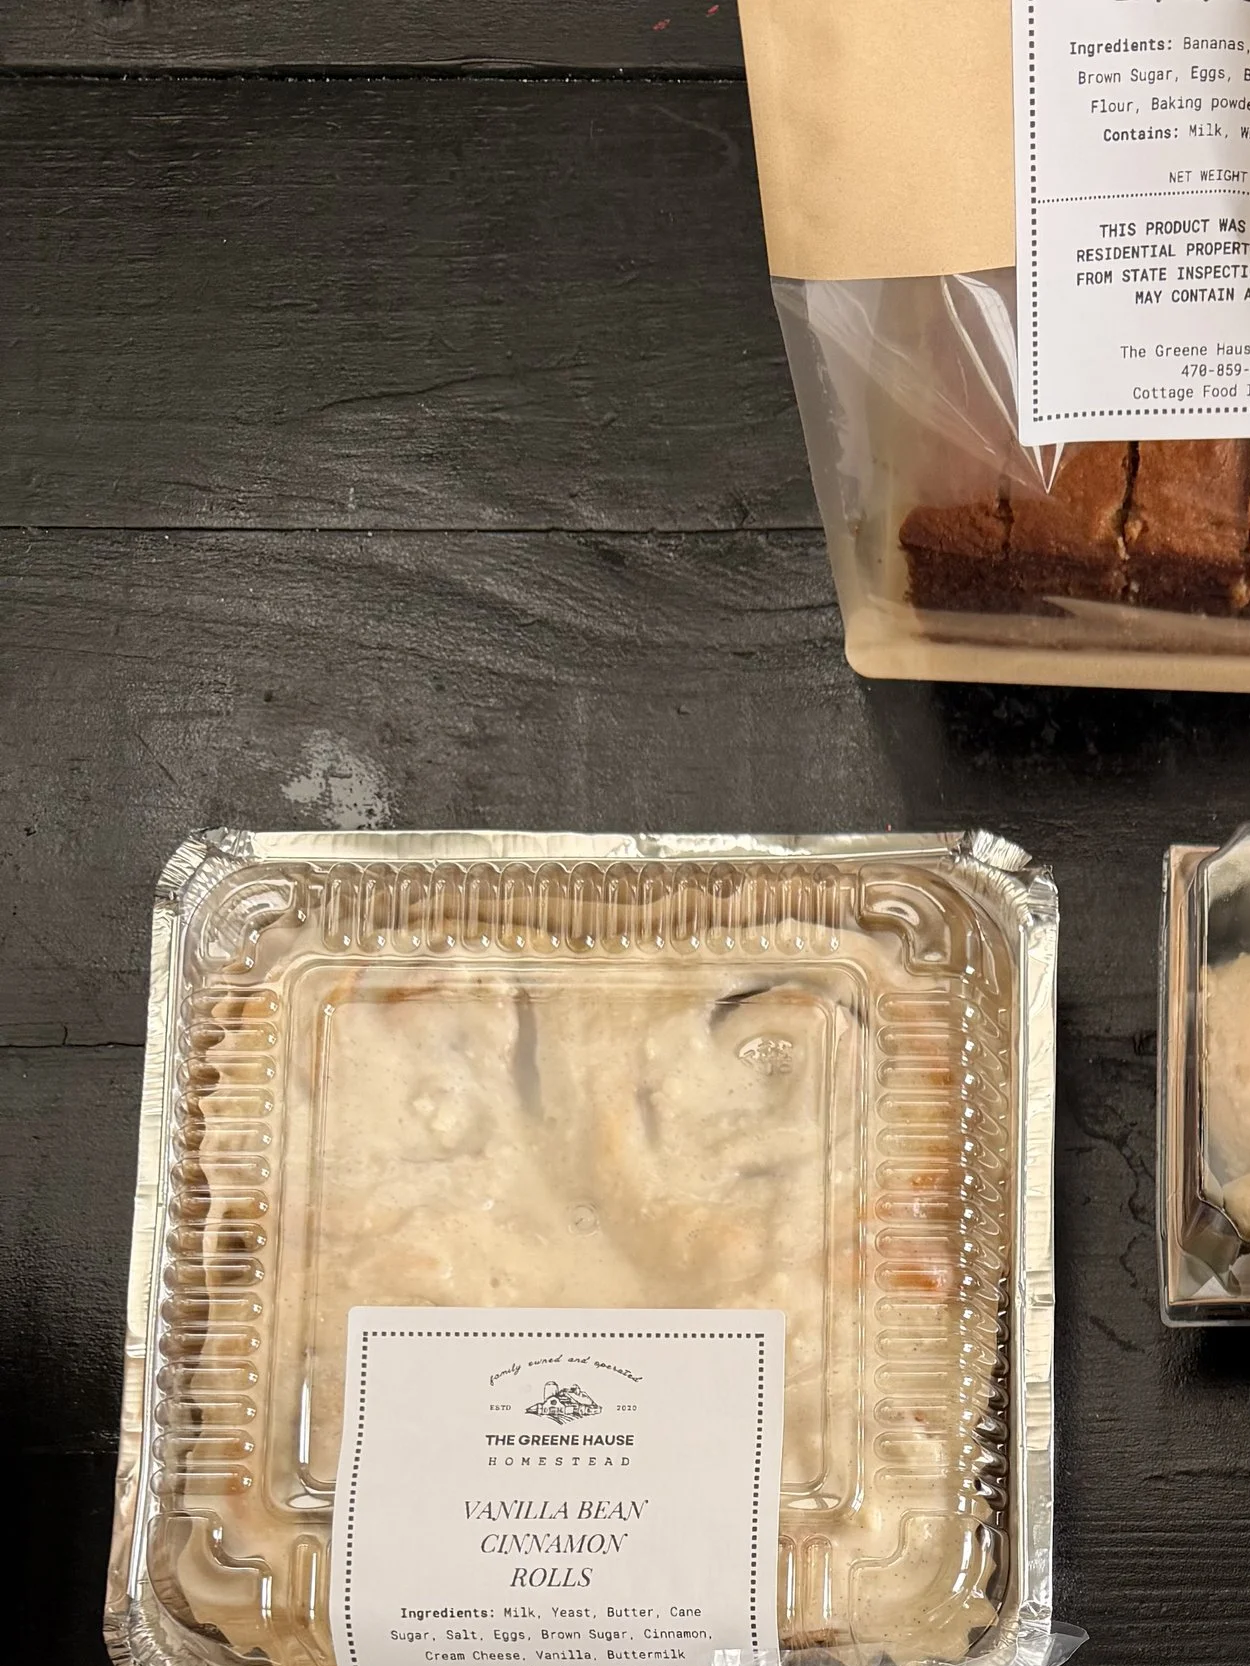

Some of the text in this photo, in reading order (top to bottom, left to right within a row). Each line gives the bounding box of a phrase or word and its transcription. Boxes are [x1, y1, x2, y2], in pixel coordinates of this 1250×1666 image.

[1070, 38, 1171, 57] Ingredients:
[1184, 37, 1250, 55] Bananas,
[1079, 71, 1121, 85] Brown
[1130, 68, 1178, 84] Sugar,
[1191, 66, 1231, 83] Eggs,
[1091, 99, 1139, 114] Flour,
[1152, 96, 1202, 111] Baking
[1104, 126, 1178, 142] Contains:
[1189, 123, 1228, 139] Milk,
[1169, 171, 1192, 183] NET
[1200, 169, 1248, 183] WEIGHT
[1099, 223, 1136, 238] THIS
[1146, 219, 1210, 236] PRODUCT
[1219, 218, 1246, 234] WAS
[1120, 345, 1146, 359] The
[1155, 345, 1207, 357] Greene
[1133, 387, 1193, 402] Cottage
[1203, 384, 1237, 398] Food
[485, 1435, 634, 1446] THE GREENE HAUSE
[465, 1500, 648, 1521] VANILLA BEAN
[481, 1533, 628, 1555] CINNAMON
[510, 1567, 593, 1587] ROLLS
[401, 1608, 494, 1621] Ingredients:
[670, 1606, 701, 1617] Cane
[541, 1629, 581, 1640] Brown
[425, 1651, 465, 1661] Cream
[607, 1649, 685, 1660] Buttermilk
